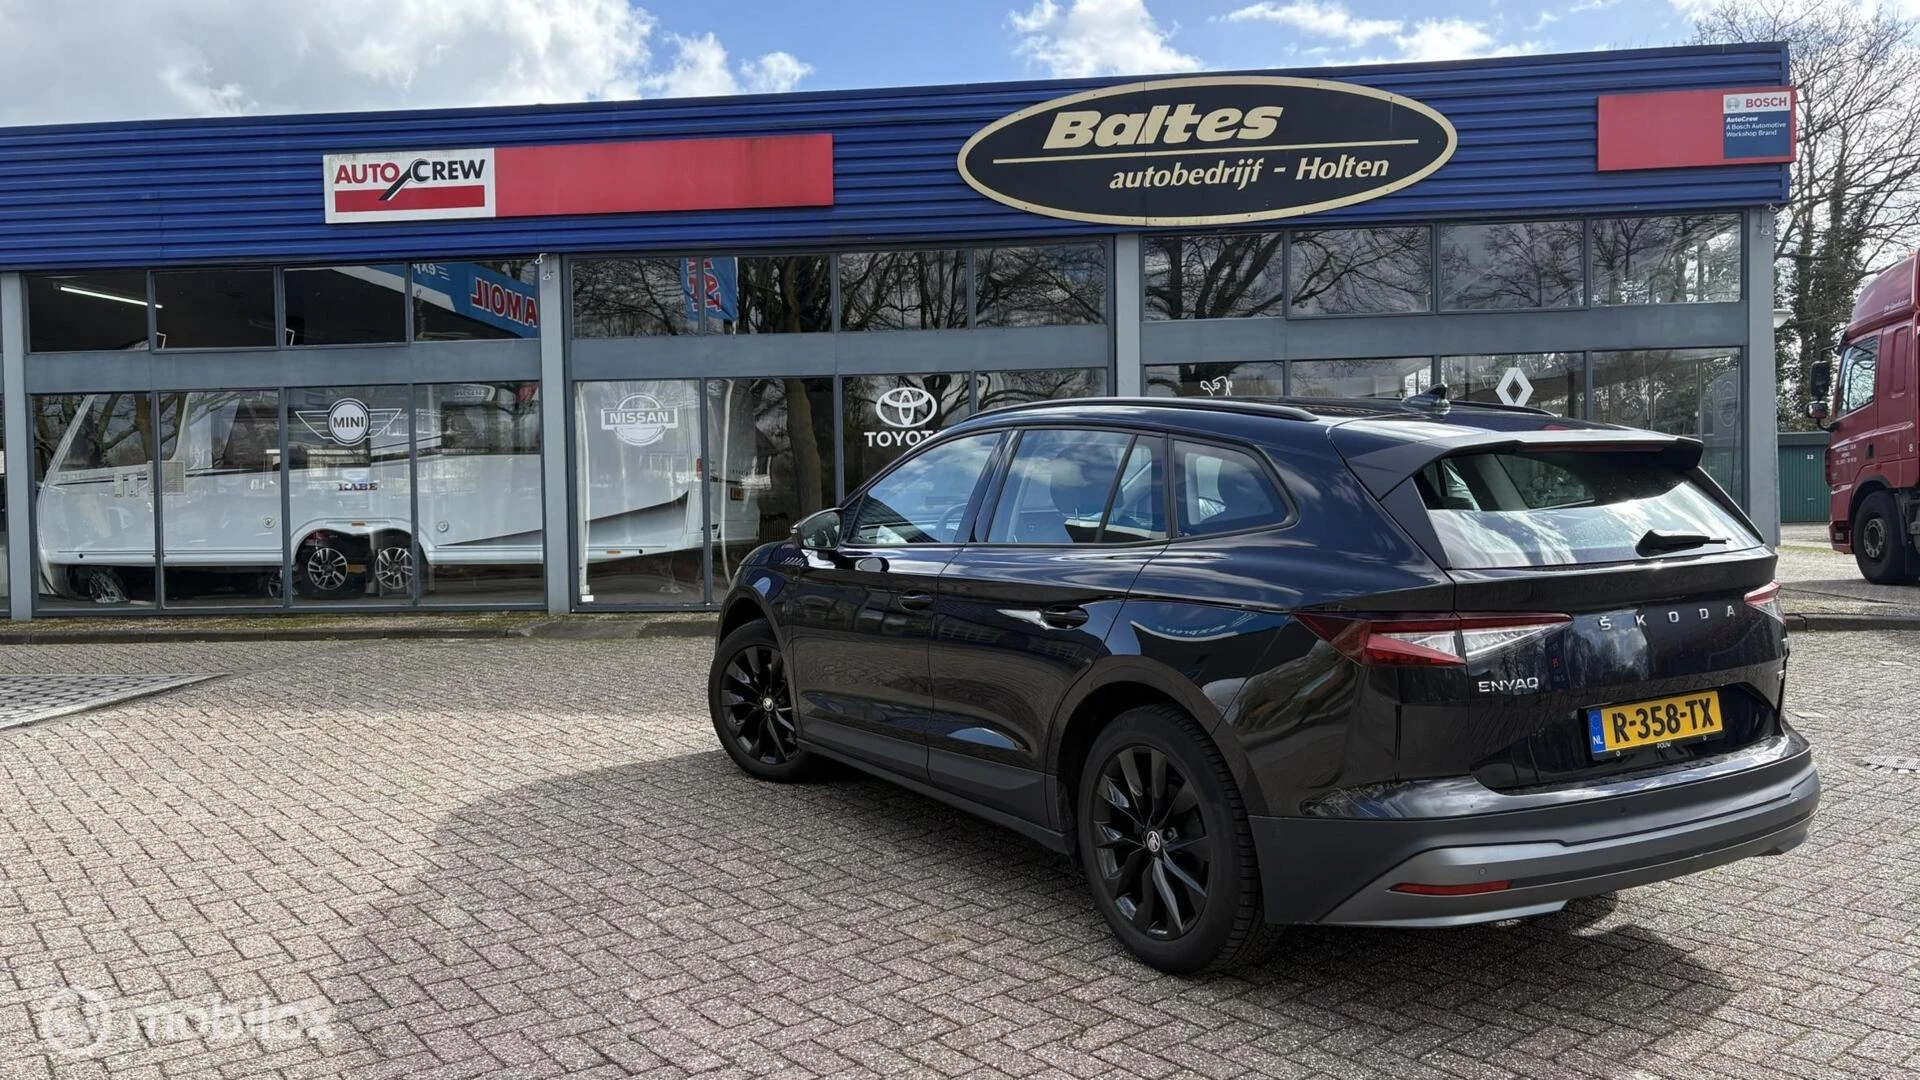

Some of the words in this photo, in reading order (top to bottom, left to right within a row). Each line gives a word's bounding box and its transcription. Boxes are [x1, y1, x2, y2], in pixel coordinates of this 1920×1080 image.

[1745, 97, 1787, 108] BOSCH
[1042, 103, 1284, 150] Baltes
[334, 162, 400, 185] AUTO
[410, 158, 486, 183] CREW
[1109, 158, 1264, 191] autobedrijf
[1296, 154, 1390, 181] Holten
[333, 416, 364, 428] MINI
[609, 411, 669, 424] NISSAN
[863, 430, 936, 448] TOYOT
[338, 482, 378, 491] KABE
[1478, 676, 1539, 693] ENYAQ
[1592, 734, 1604, 745] NL
[1611, 697, 1715, 744] R-358-TX
